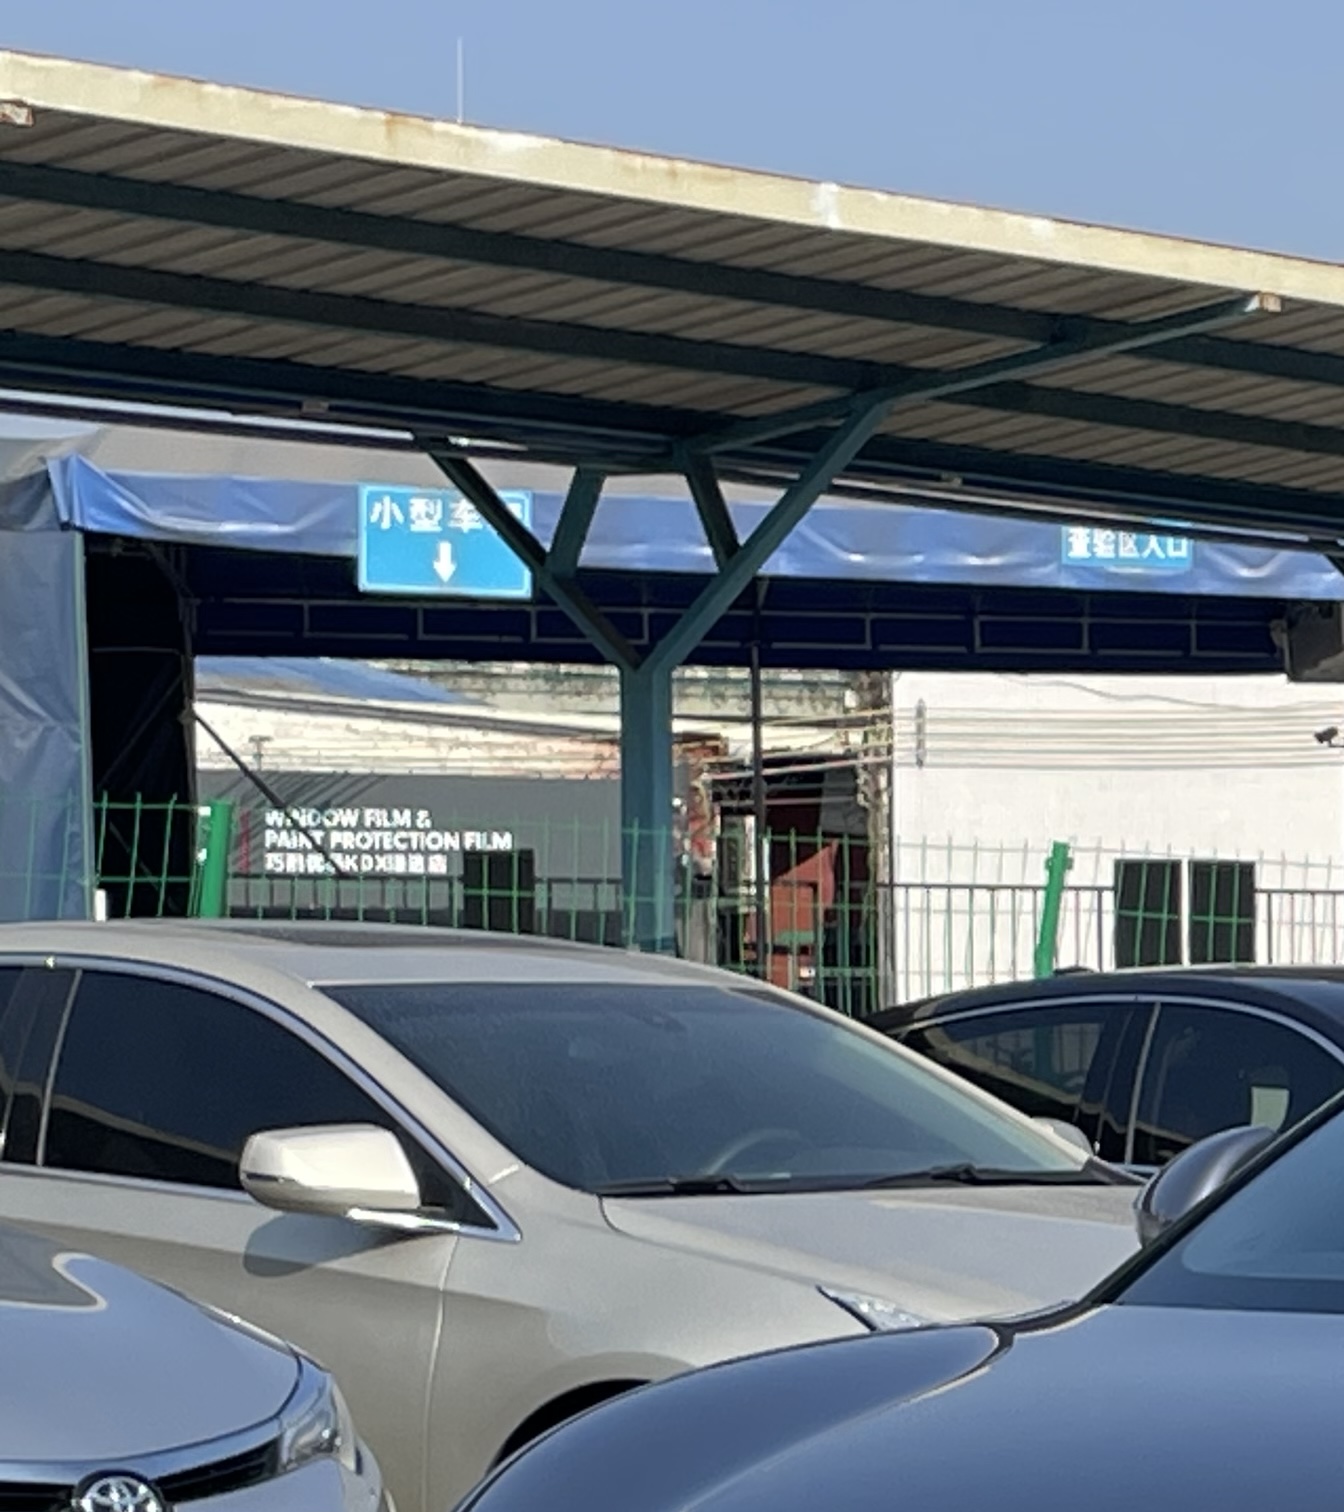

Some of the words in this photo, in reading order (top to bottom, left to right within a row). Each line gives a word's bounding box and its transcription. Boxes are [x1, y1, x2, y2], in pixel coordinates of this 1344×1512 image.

[364, 808, 412, 829] FILM
[416, 811, 432, 829] &
[265, 829, 325, 849] PAINT
[330, 831, 461, 850] PROTECTION
[465, 831, 512, 850] FILM
